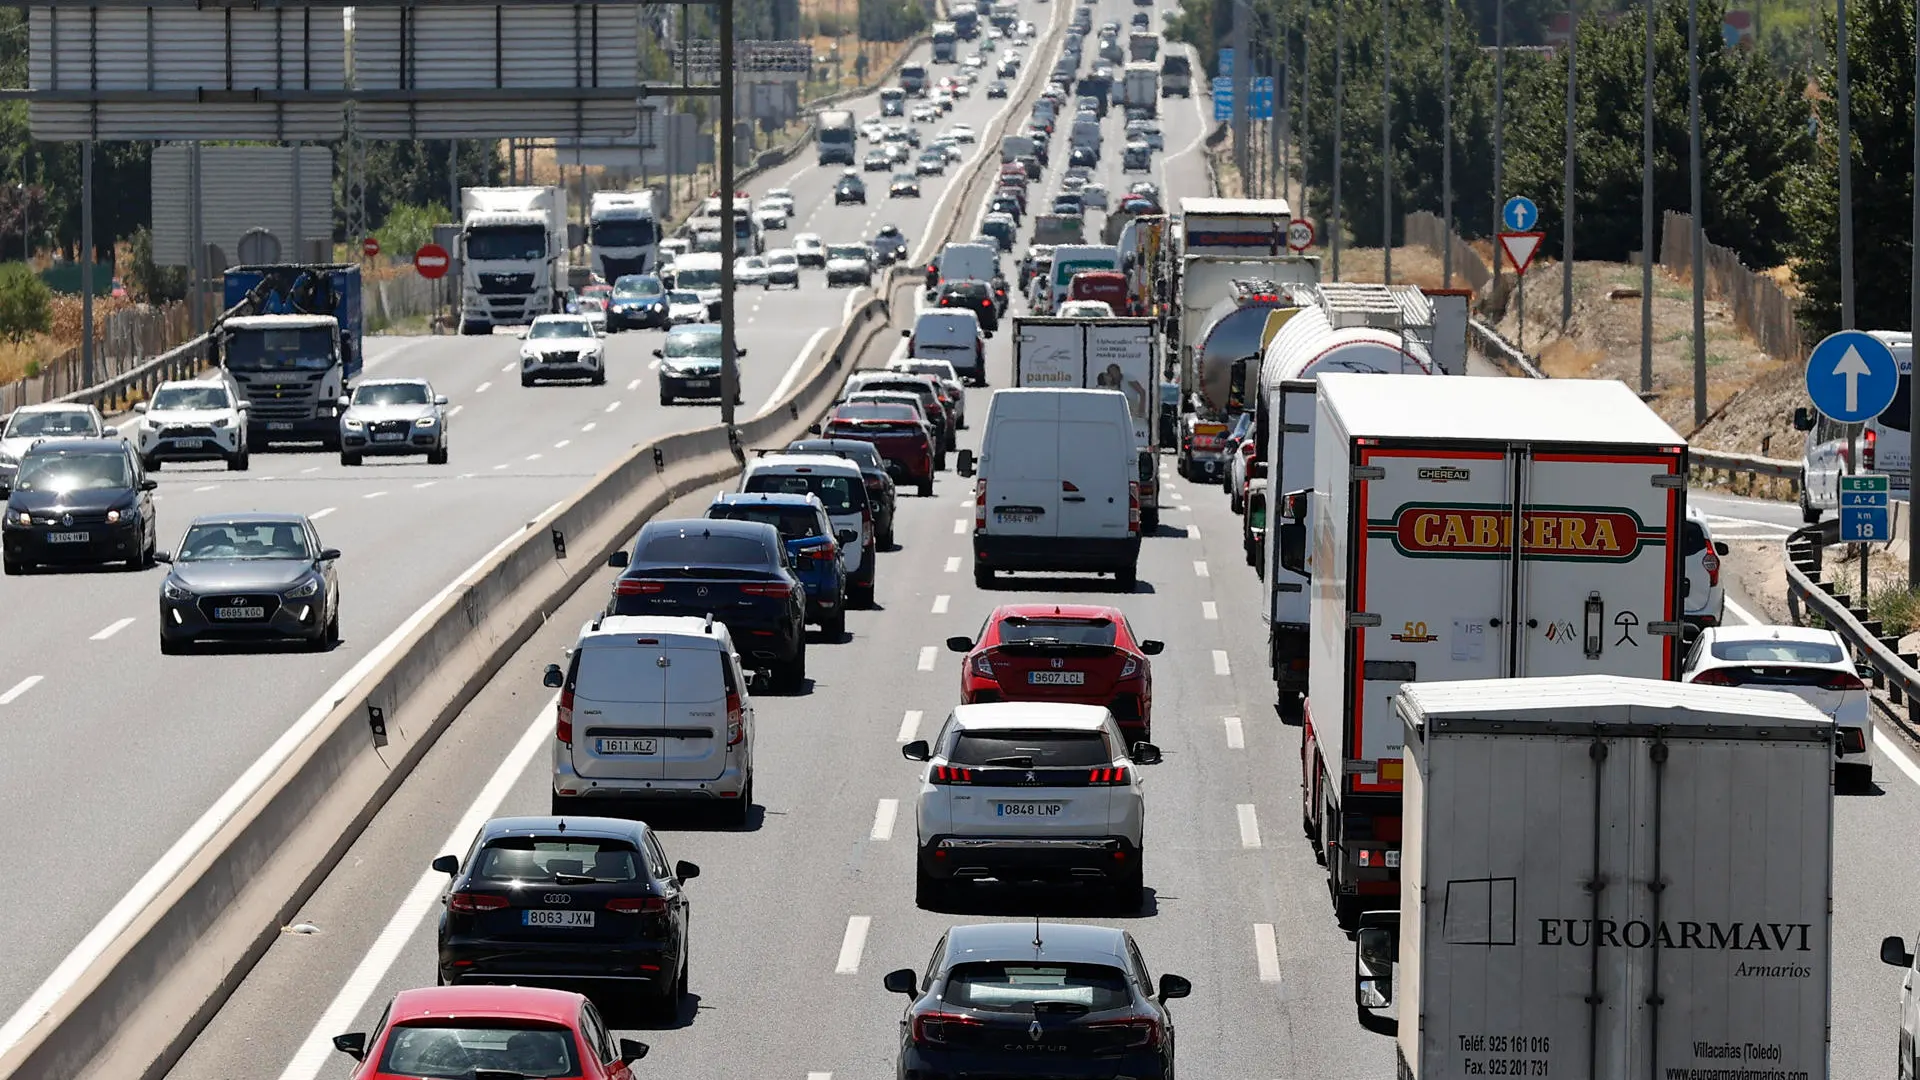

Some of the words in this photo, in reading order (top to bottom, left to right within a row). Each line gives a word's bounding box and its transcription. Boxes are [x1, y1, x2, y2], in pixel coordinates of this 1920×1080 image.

[1419, 470, 1469, 480] CHEREAU
[1853, 479, 1875, 489] E-5
[1853, 494, 1876, 505] A-4
[1857, 511, 1872, 520] km
[1413, 513, 1621, 551] CABRERA
[1855, 523, 1874, 538] 18
[220, 608, 242, 617] 6695
[1403, 621, 1428, 637] 50
[1035, 673, 1060, 682] 9607
[1063, 673, 1082, 683] LCL
[606, 741, 629, 751] 1611
[633, 741, 652, 751] KLZ
[1005, 804, 1035, 815] 0848
[1037, 805, 1061, 816] LNP
[530, 911, 563, 924] 8063
[567, 912, 592, 925] JXM
[1538, 917, 1812, 951] EUROARMAVI
[1734, 961, 1811, 979] Armarios
[1003, 1043, 1068, 1052] CAPTUR
[1459, 1034, 1486, 1052] Teléf.
[1489, 1036, 1507, 1052] 925
[1511, 1036, 1528, 1052] 161
[1531, 1037, 1550, 1053] 016
[1693, 1041, 1741, 1059] Villacañas
[1743, 1043, 1782, 1064] (Toledo)
[1464, 1058, 1486, 1076] Fax.
[1488, 1059, 1507, 1076] 925
[1509, 1059, 1527, 1076] 201
[1531, 1060, 1548, 1076] 731
